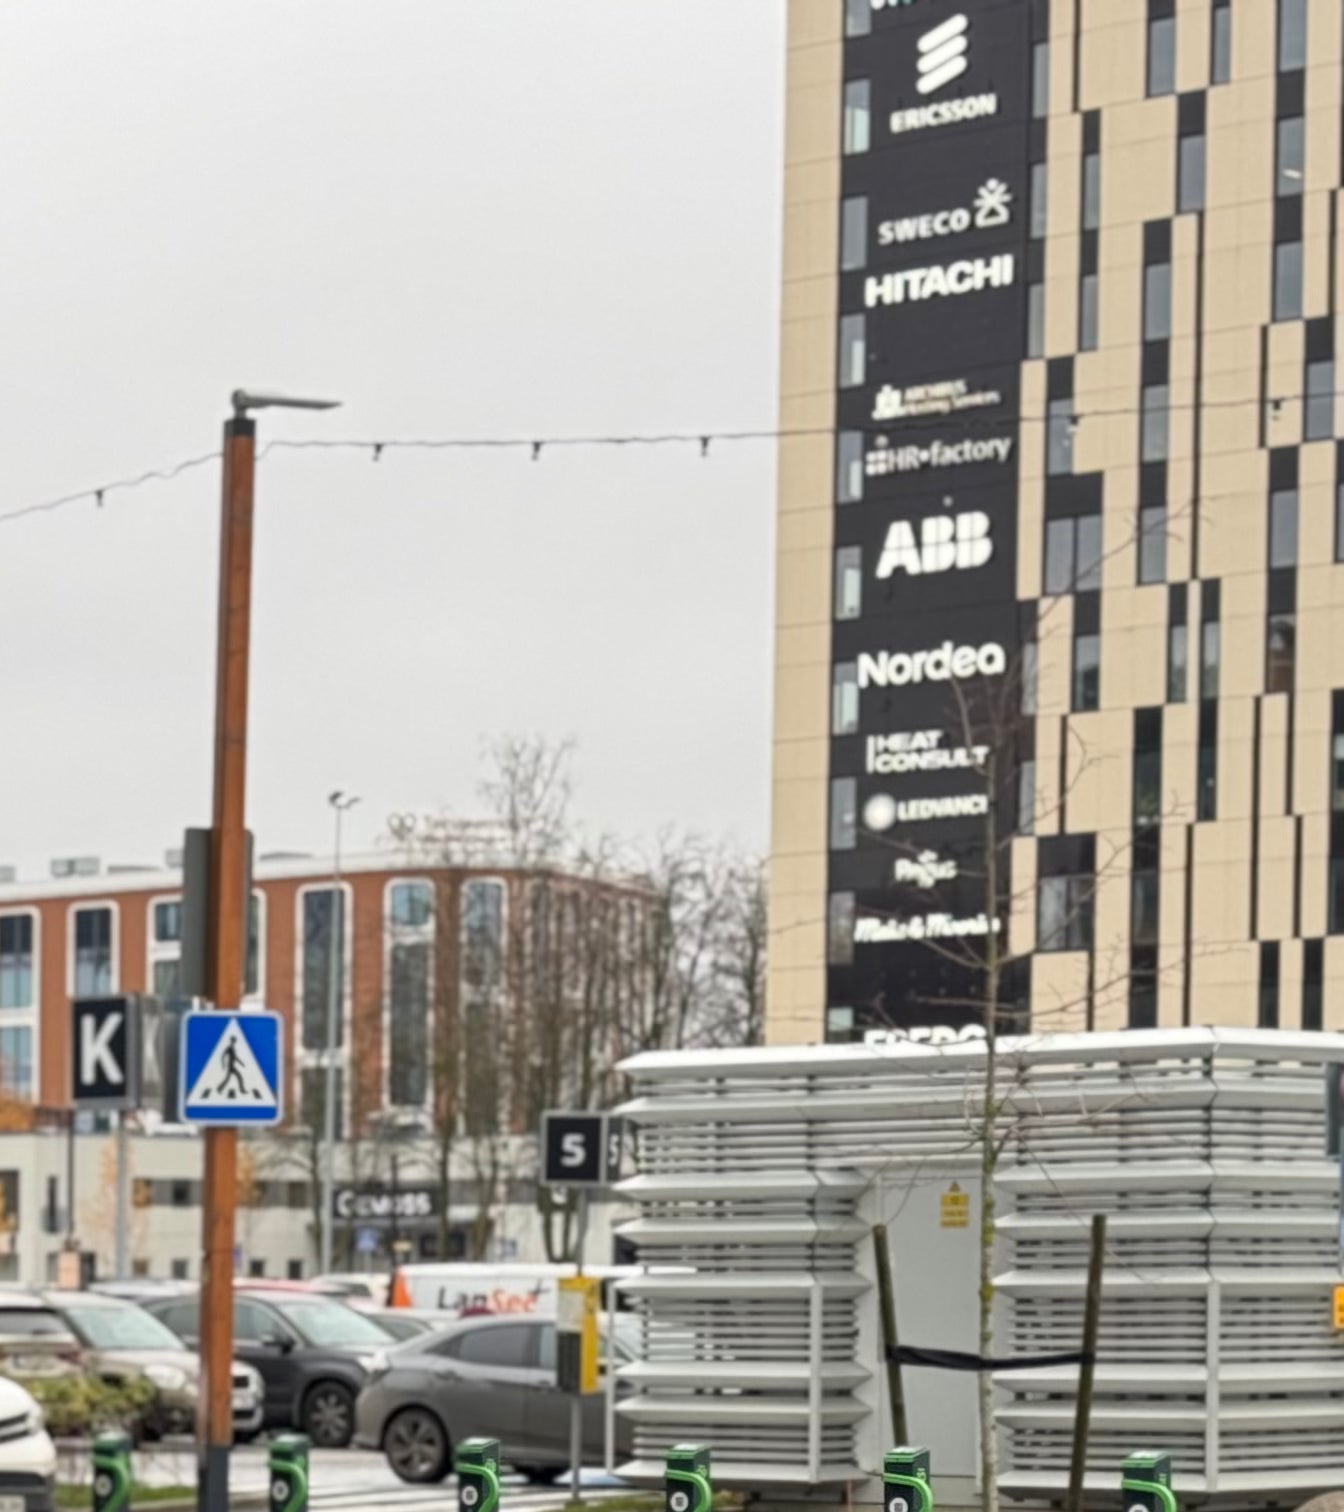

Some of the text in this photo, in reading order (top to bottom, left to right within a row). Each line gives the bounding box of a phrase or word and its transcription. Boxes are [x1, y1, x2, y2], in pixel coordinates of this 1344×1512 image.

[890, 92, 997, 134] ERICSSON
[878, 208, 971, 245] SWECO
[864, 254, 1014, 308] HITACHI
[875, 511, 993, 580] ABB
[857, 641, 1006, 688] Nordea
[874, 744, 990, 774] CONSULT
[876, 729, 944, 752] HEAT
[80, 1012, 124, 1085] K
[561, 1132, 586, 1167] 5
